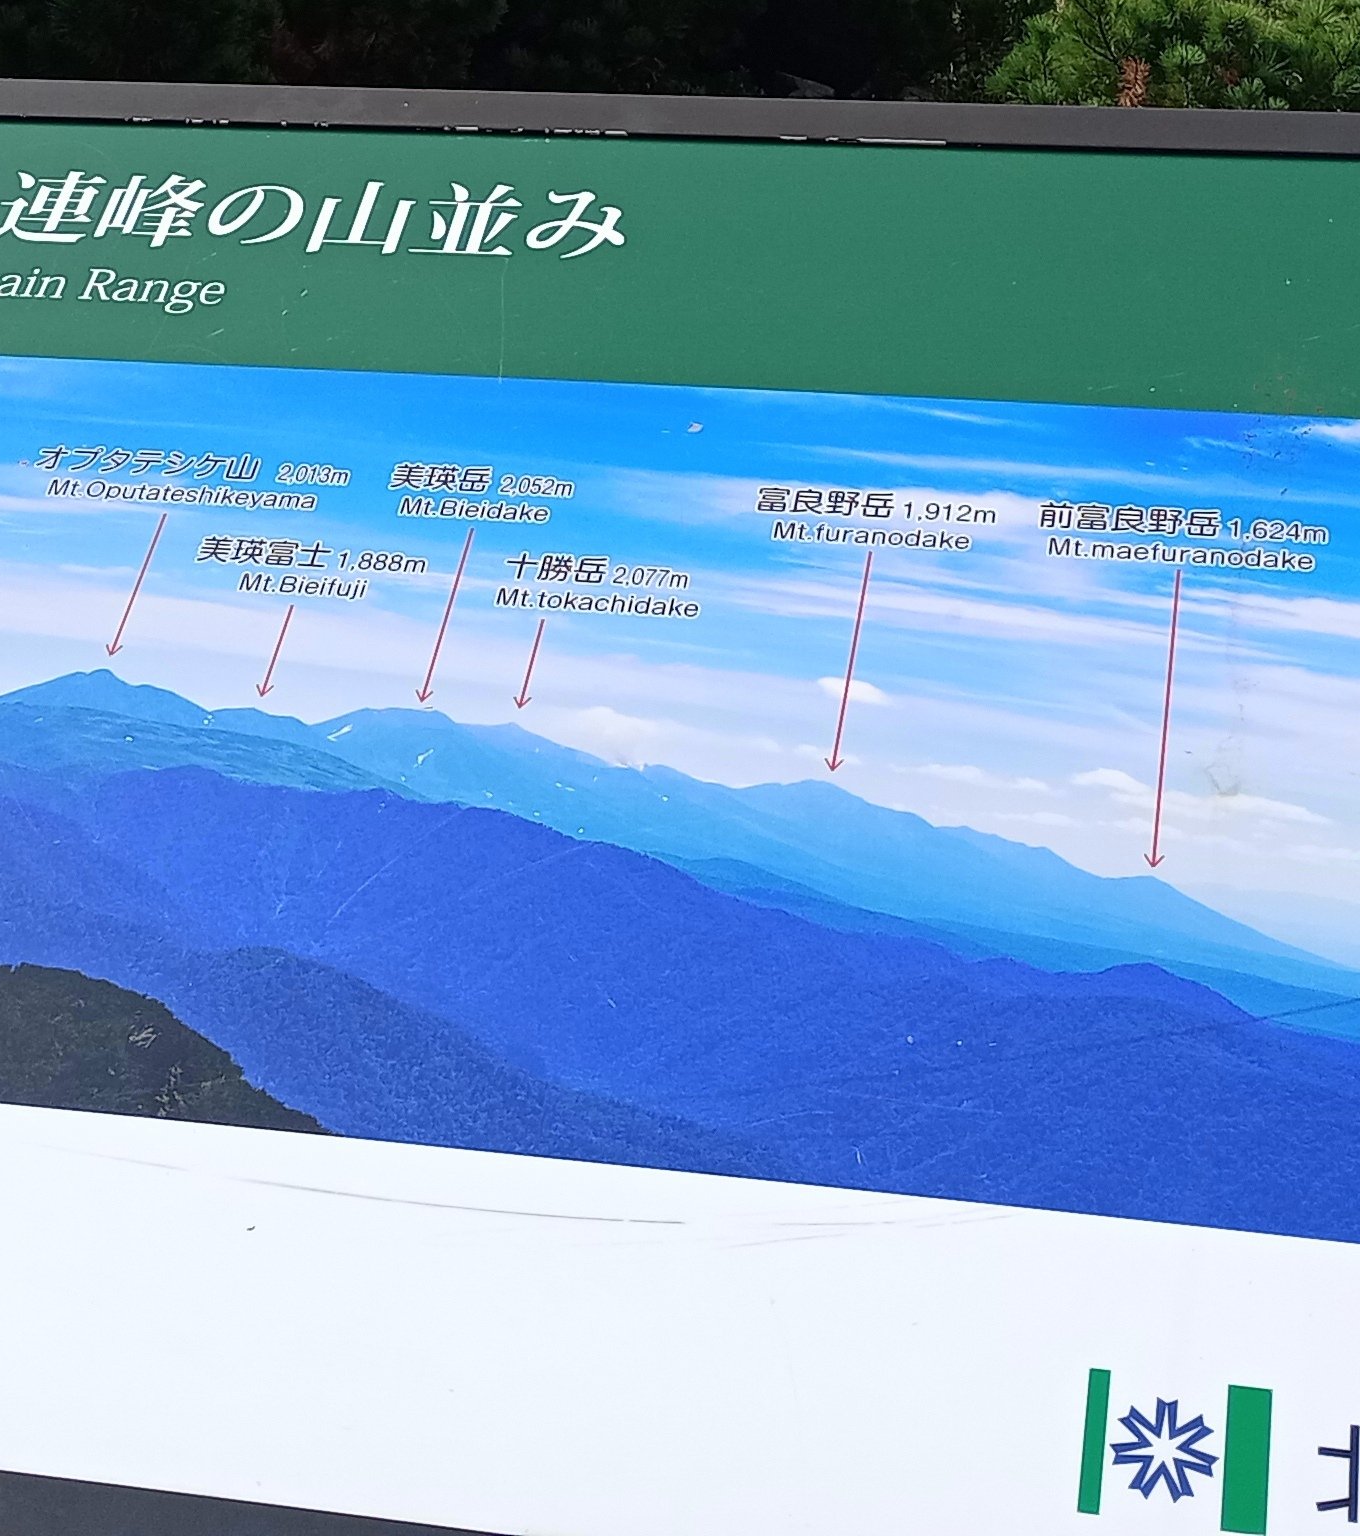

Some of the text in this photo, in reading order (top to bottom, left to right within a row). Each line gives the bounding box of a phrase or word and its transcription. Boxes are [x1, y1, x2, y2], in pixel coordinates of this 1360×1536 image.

[77, 268, 226, 316] Range
[36, 447, 349, 484] オプタテシケ山 2,013m
[392, 463, 573, 497] 美瑛岳 2,052m
[757, 487, 996, 524] 富良野岳 1,912m
[1039, 501, 1220, 537] 前富良野岳
[199, 536, 427, 574] 美瑛富士 1,888m
[507, 552, 689, 589] 十勝岳 2,077m
